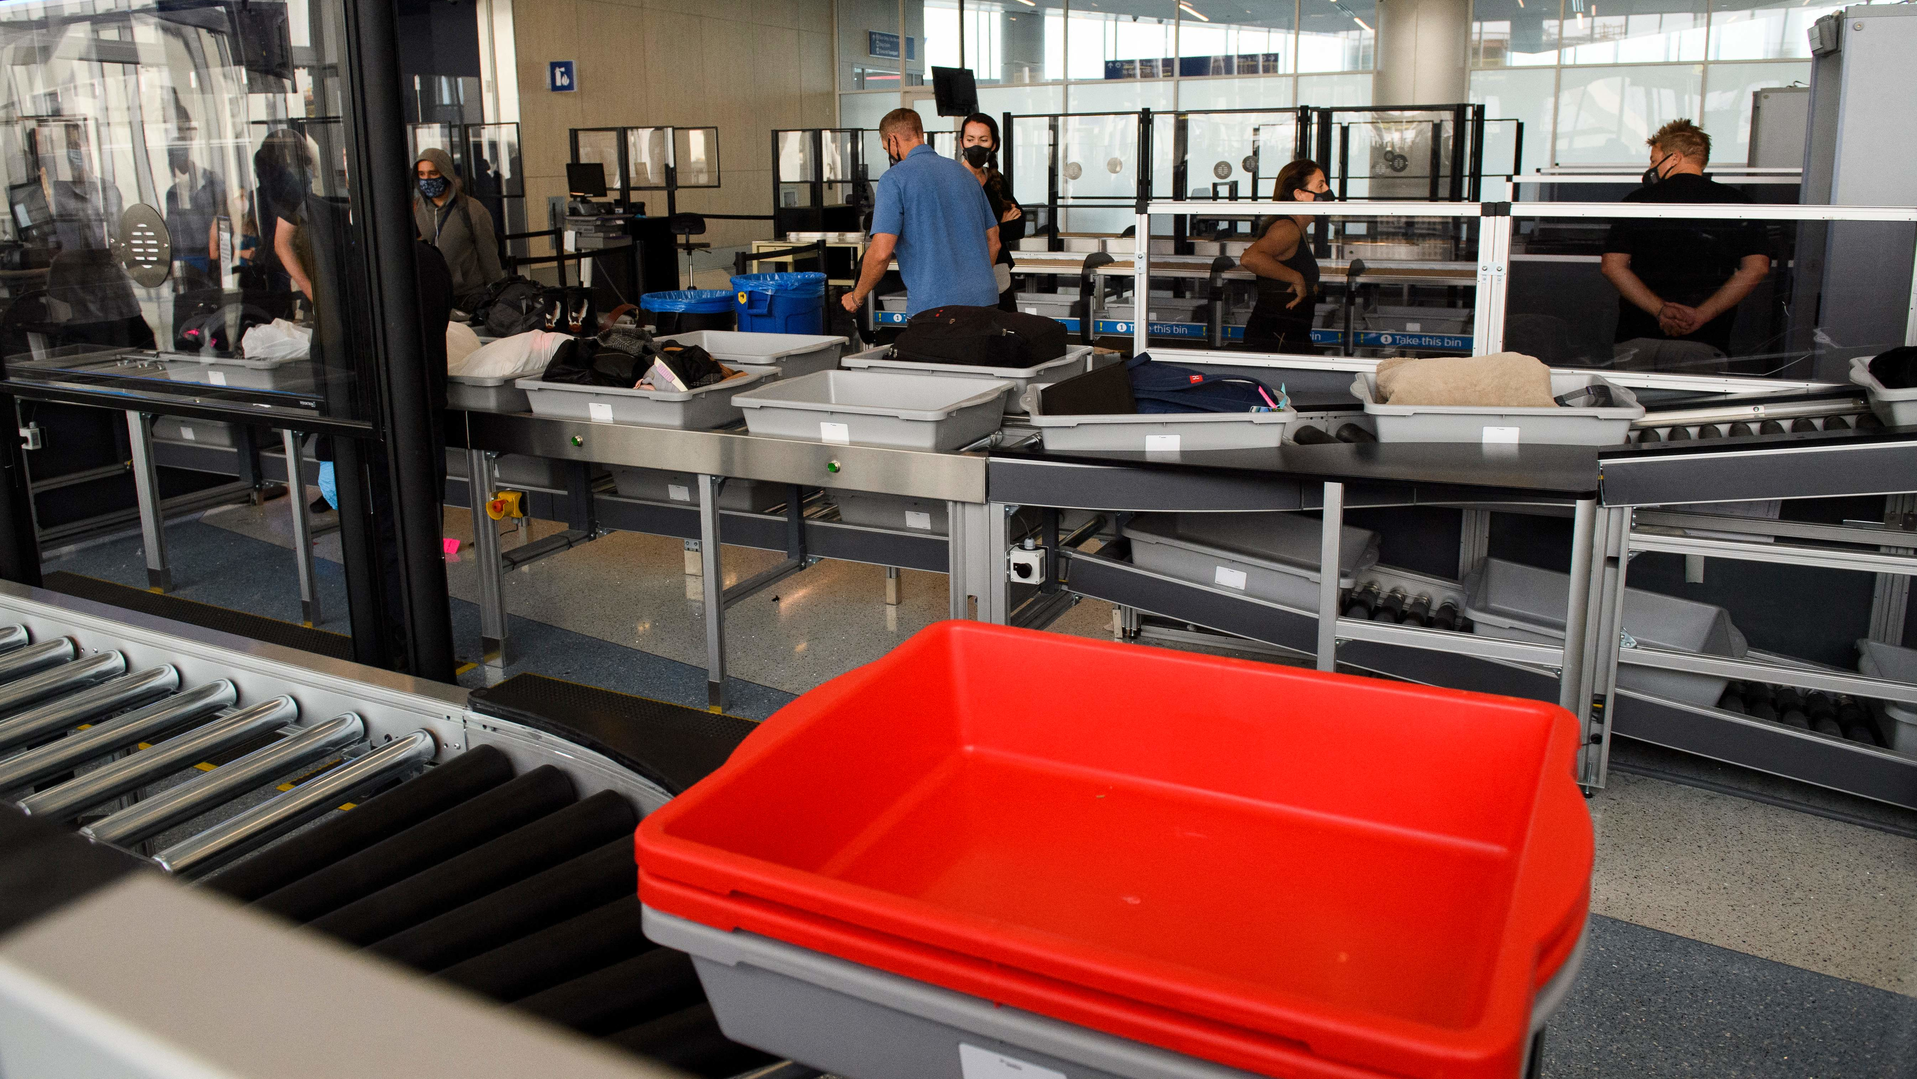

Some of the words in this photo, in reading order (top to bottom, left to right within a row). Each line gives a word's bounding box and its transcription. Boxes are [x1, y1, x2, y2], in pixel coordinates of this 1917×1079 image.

[1154, 325, 1171, 333] this
[1173, 326, 1188, 334] bin
[1309, 332, 1321, 340] in
[1394, 336, 1420, 344] Take
[1422, 337, 1442, 346] this
[1444, 338, 1462, 347] bin
